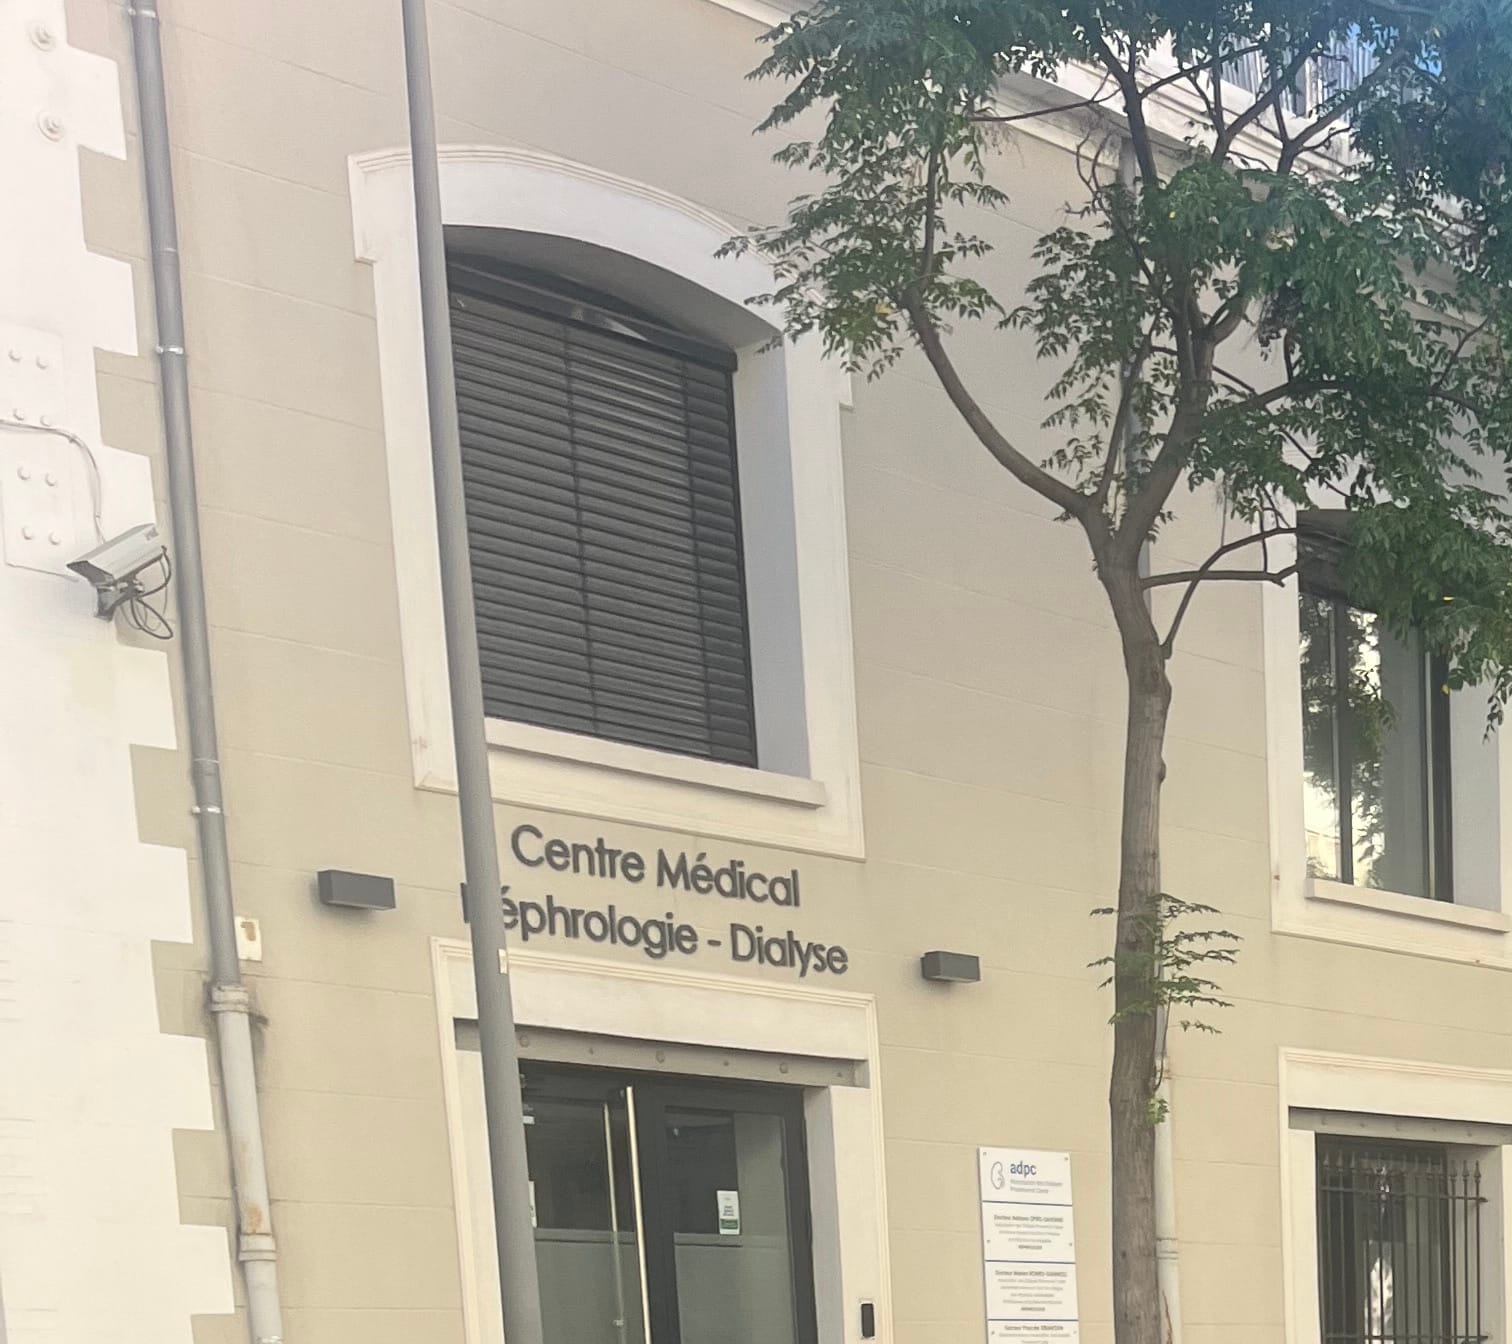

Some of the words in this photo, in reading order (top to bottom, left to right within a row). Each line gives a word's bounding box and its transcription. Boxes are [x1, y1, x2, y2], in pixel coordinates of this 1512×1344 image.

[511, 824, 645, 883] Centre
[656, 849, 800, 908] Médical
[461, 883, 699, 960] éphrologie
[730, 922, 849, 978] Dialyse
[1010, 1160, 1037, 1178] adpc
